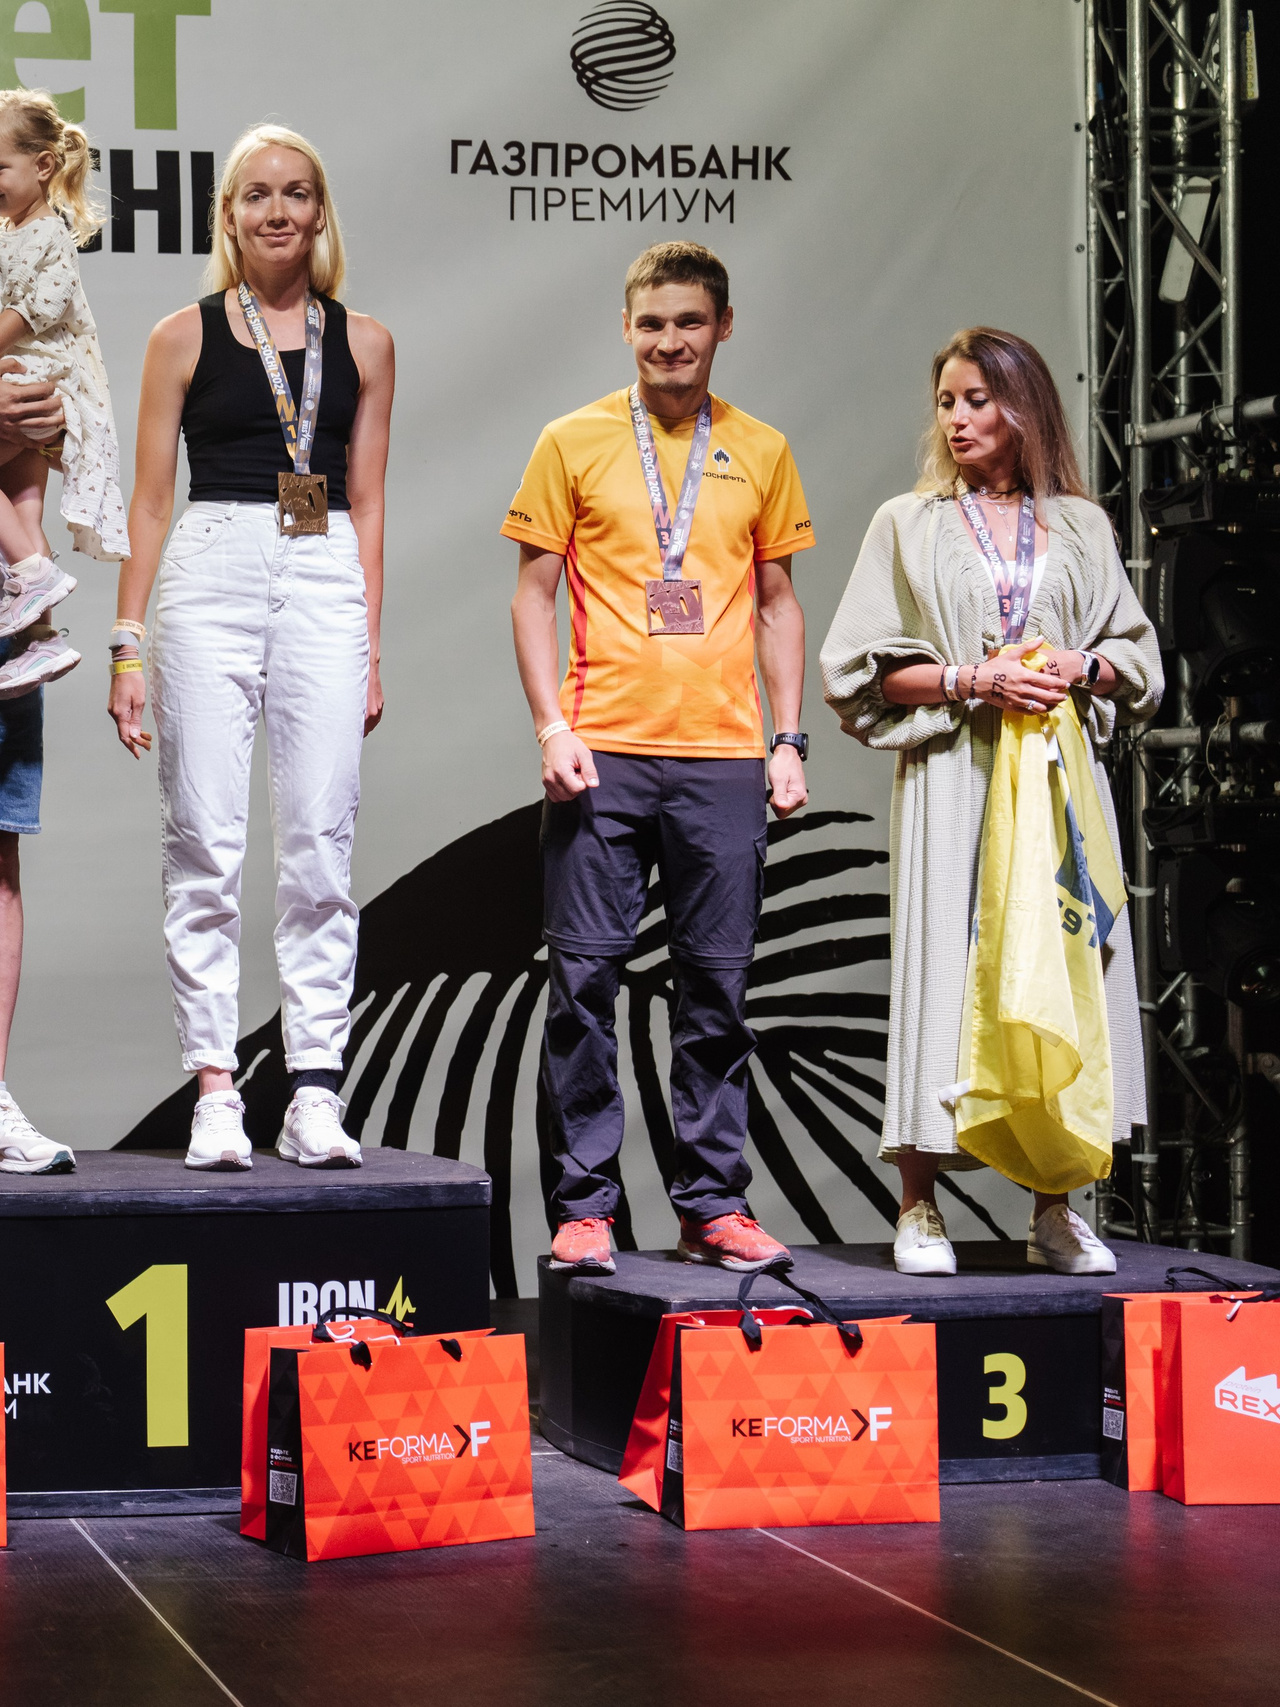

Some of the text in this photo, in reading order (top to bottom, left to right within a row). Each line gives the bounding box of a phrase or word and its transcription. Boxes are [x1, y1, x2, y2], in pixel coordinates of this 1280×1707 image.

[450, 139, 792, 181] ГАЗПРОМБАНК
[509, 186, 735, 224] ПРЕМИУМ
[245, 306, 258, 319] 113
[250, 317, 269, 344] SIRIUS
[261, 343, 279, 371] SOCHI
[270, 371, 286, 396] 2024
[286, 424, 297, 439] 1
[630, 382, 663, 503] STAR 113 SIRIUS SOCHI 2024
[508, 509, 533, 523] ФТЬ
[794, 519, 812, 531] РО
[966, 505, 984, 529] SIRIUS
[976, 529, 995, 551] SOCHI
[660, 531, 670, 546] 3
[1001, 598, 1011, 613] 3
[1046, 660, 1062, 680] 37
[991, 672, 1007, 700] 378
[278, 1280, 375, 1327] IRON
[105, 1263, 189, 1448] 1
[982, 1352, 1028, 1440] 3
[1219, 1388, 1280, 1420] REX
[732, 1415, 851, 1438] KEFORMA
[790, 1435, 852, 1444] SPORT NUTRITION
[348, 1432, 455, 1462] KEFORMA
[401, 1452, 456, 1465] SPORT NUTRITION
